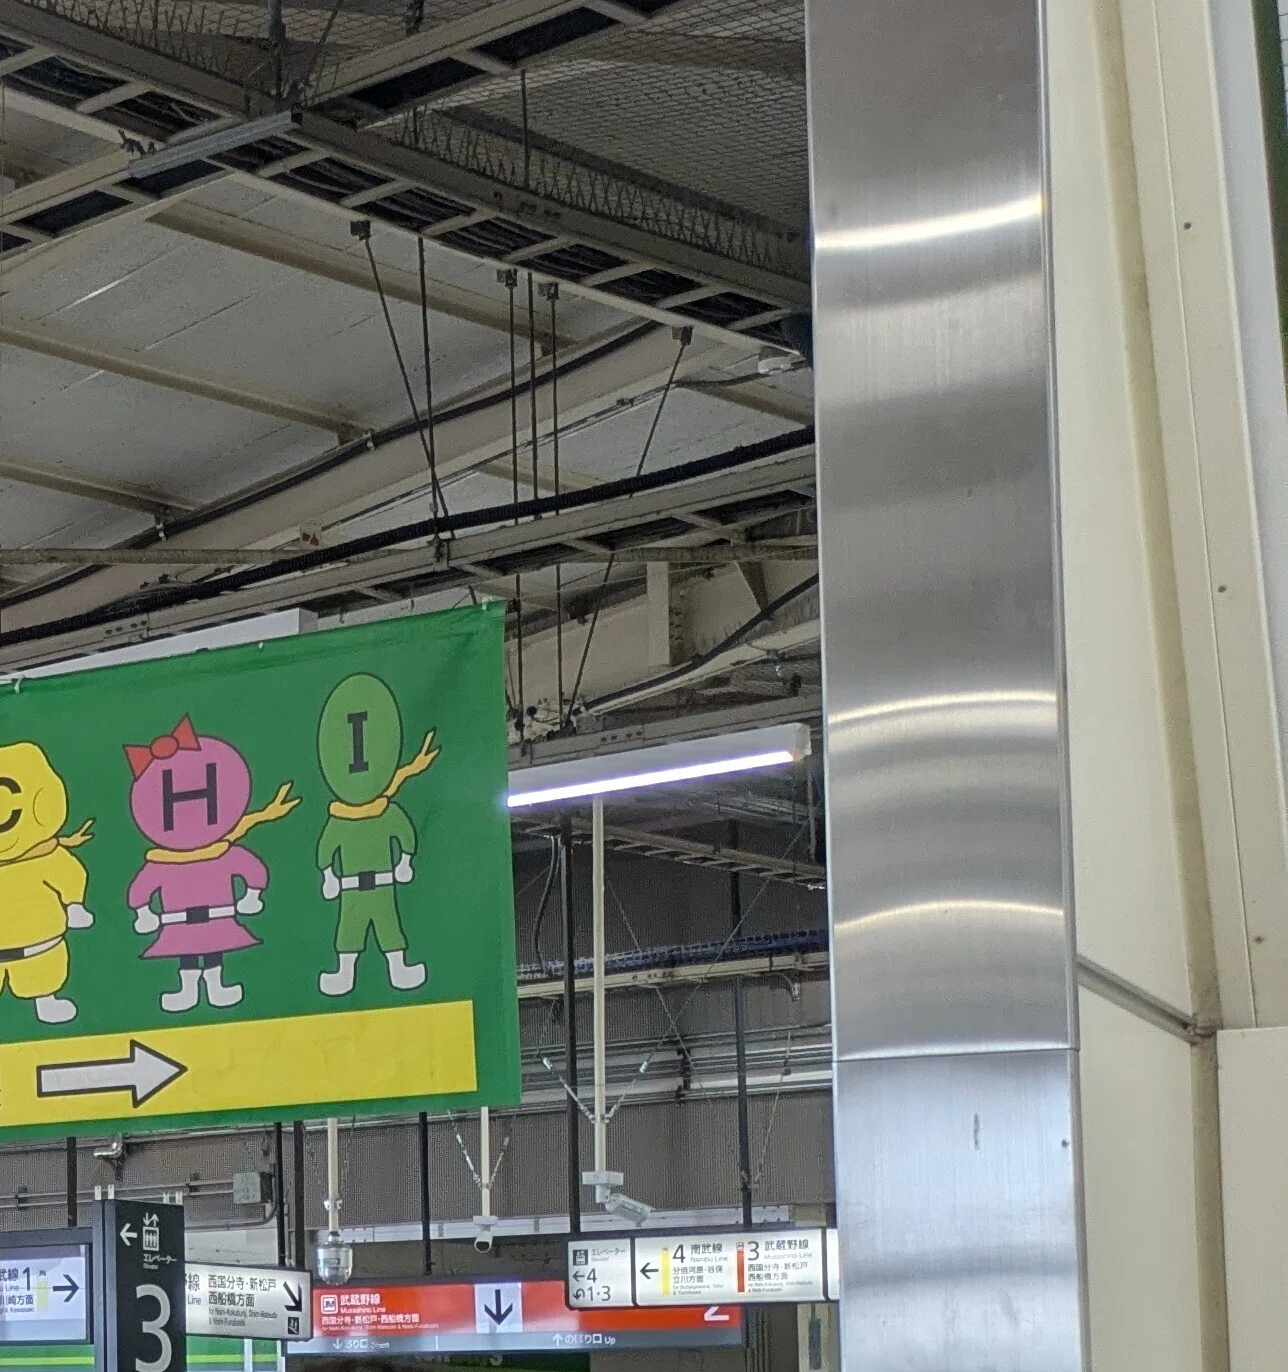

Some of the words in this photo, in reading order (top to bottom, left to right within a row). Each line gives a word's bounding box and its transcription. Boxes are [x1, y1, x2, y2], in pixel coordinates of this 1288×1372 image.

[347, 711, 370, 773] I
[161, 761, 218, 832] H
[672, 1244, 687, 1264] 4
[690, 1243, 723, 1255] 南武線
[747, 1240, 760, 1261] 3
[764, 1239, 810, 1252] 武蔵野線
[22, 1267, 31, 1290] 1
[208, 1274, 277, 1291] 西国分寺・新松戸
[587, 1269, 598, 1283] 4
[208, 1291, 255, 1308] 西船橋方面
[340, 1294, 381, 1306] 武蔵野線
[604, 1335, 616, 1346] Up
